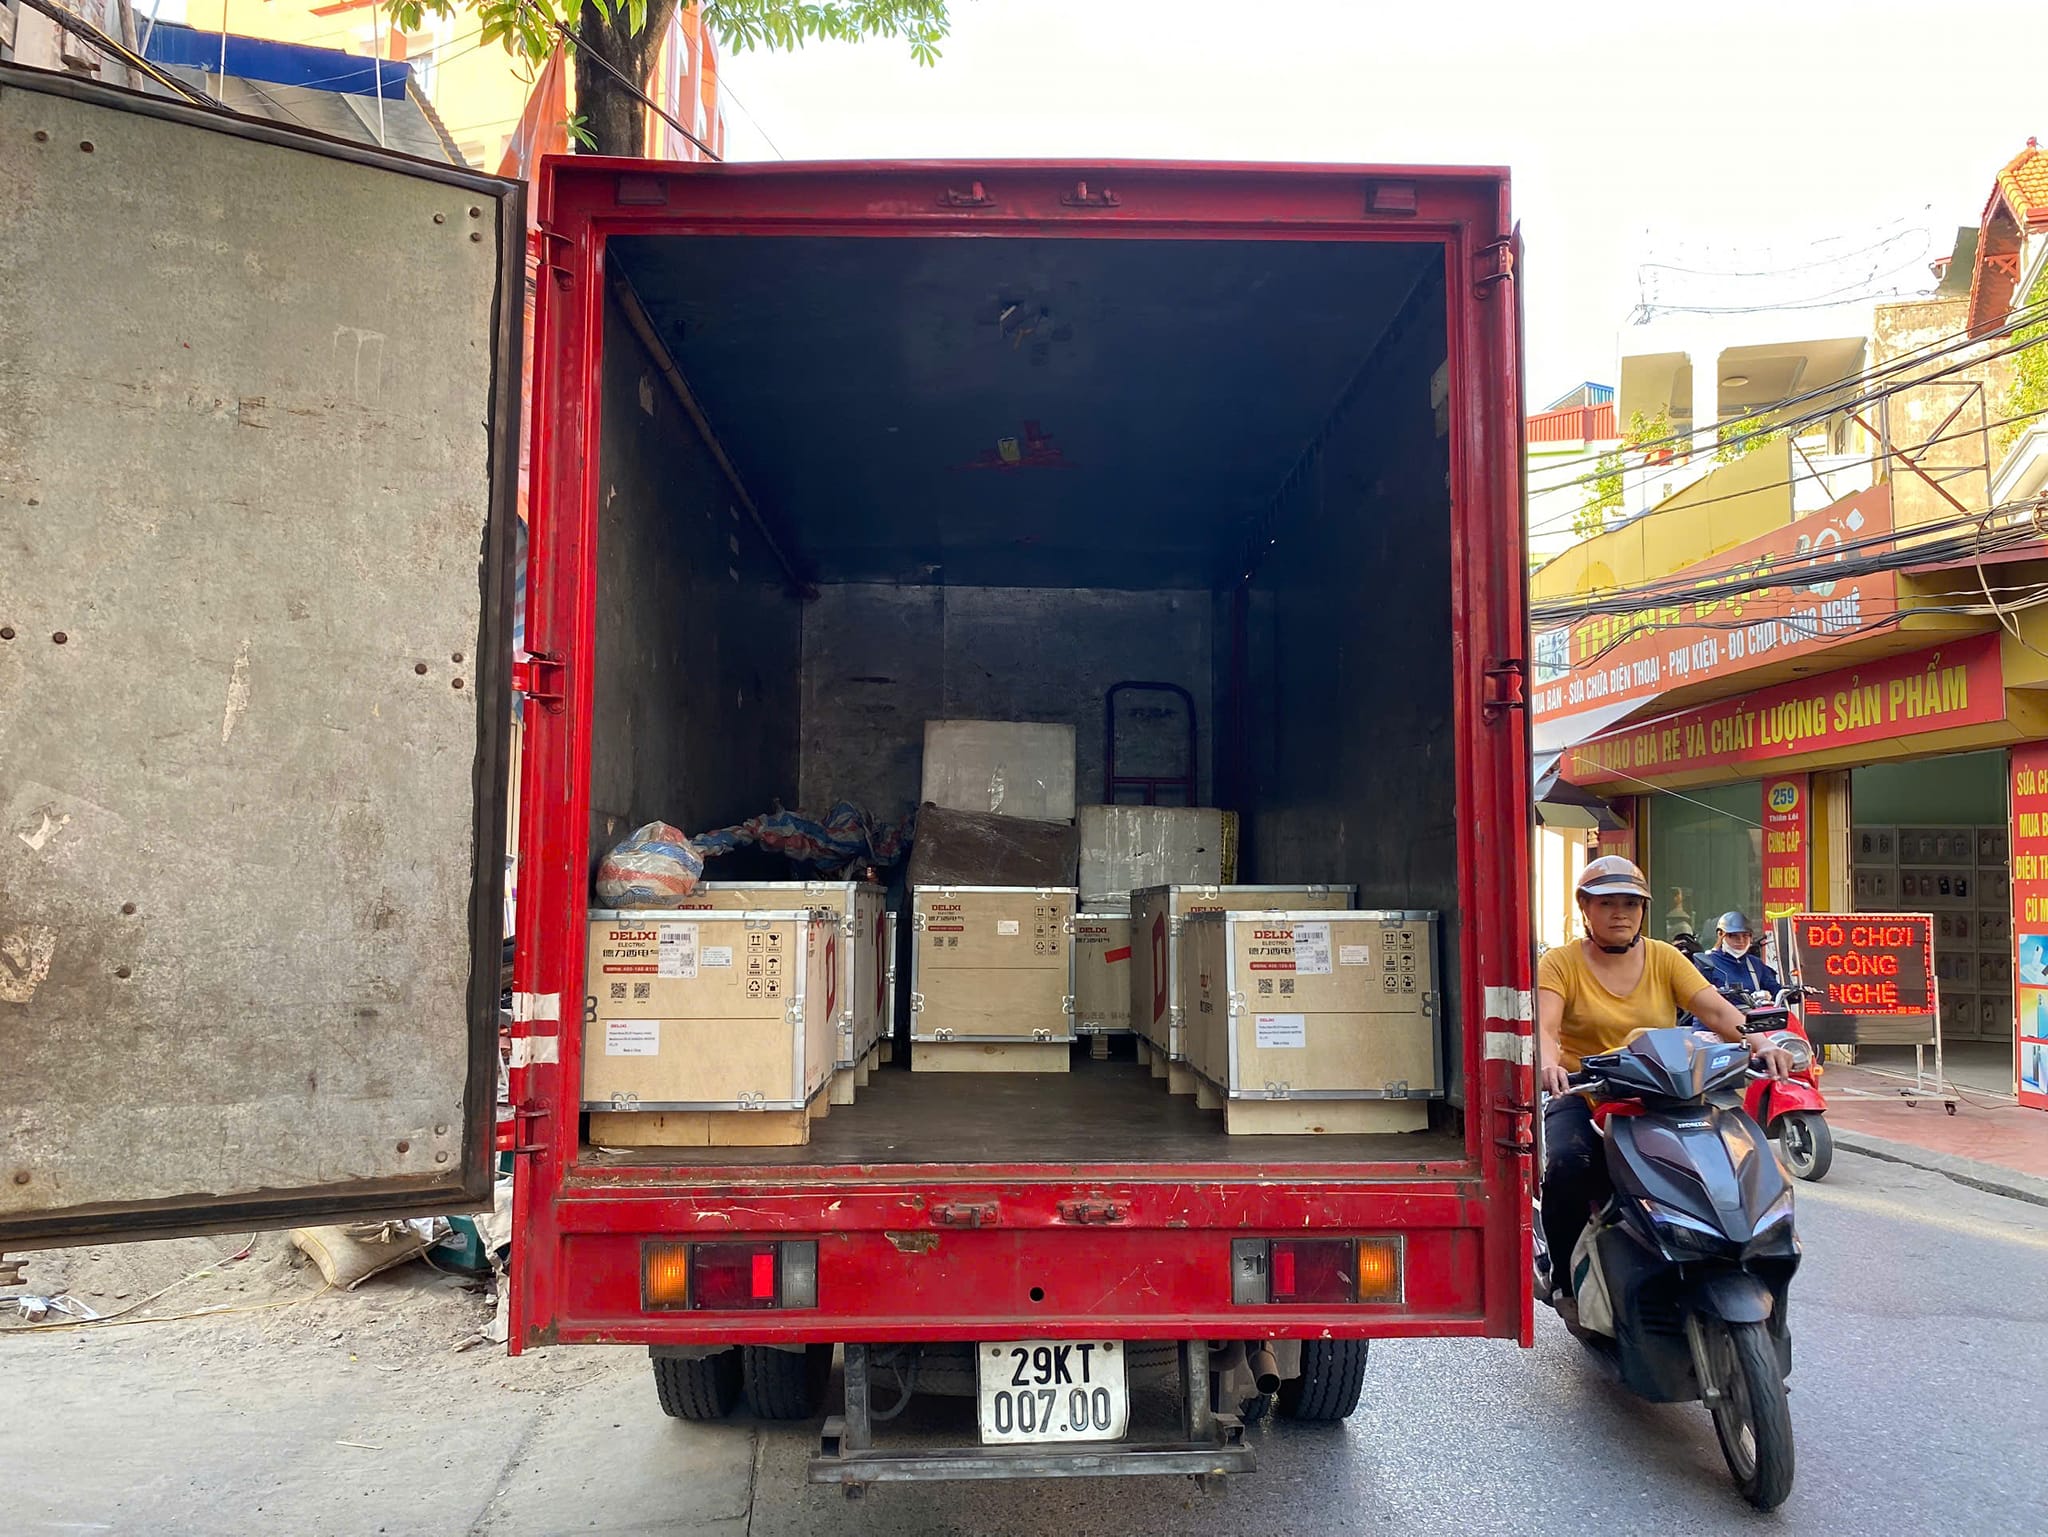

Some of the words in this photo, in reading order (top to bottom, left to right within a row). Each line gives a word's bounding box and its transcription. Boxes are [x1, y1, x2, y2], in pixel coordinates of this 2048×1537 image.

[1610, 662, 1631, 696] ĐIỆN
[1633, 656, 1660, 688] THOẠI
[1669, 647, 1689, 679] PHỤ
[1693, 635, 1718, 674] KIỆN
[1821, 586, 1862, 634] NGHỆ
[1634, 727, 1658, 767] GIÁ
[1662, 718, 1681, 761] RẺ
[1685, 717, 1706, 758] VÀ
[1711, 701, 1756, 754] CHẤT
[1760, 697, 1827, 749] LƯỢNG
[1833, 675, 1881, 732] SẢN
[1889, 652, 1968, 722] PHẨM
[2016, 764, 2036, 796] SỬA
[1773, 787, 1794, 806] 259
[2019, 813, 2040, 838] MUA
[1768, 867, 1783, 889] LINH
[1784, 862, 1800, 893] KIỆN
[2015, 850, 2037, 885] ĐIỆN
[609, 931, 657, 941] DELIXI
[1253, 930, 1294, 939] DELIX
[1851, 925, 1914, 947] CHƠI
[1248, 947, 1295, 956] 德力西电
[1826, 950, 1898, 976] CÔNG
[1829, 980, 1899, 1008] NGHỆ
[1011, 1343, 1095, 1386] 29KT
[994, 1387, 1111, 1434] 007.00
